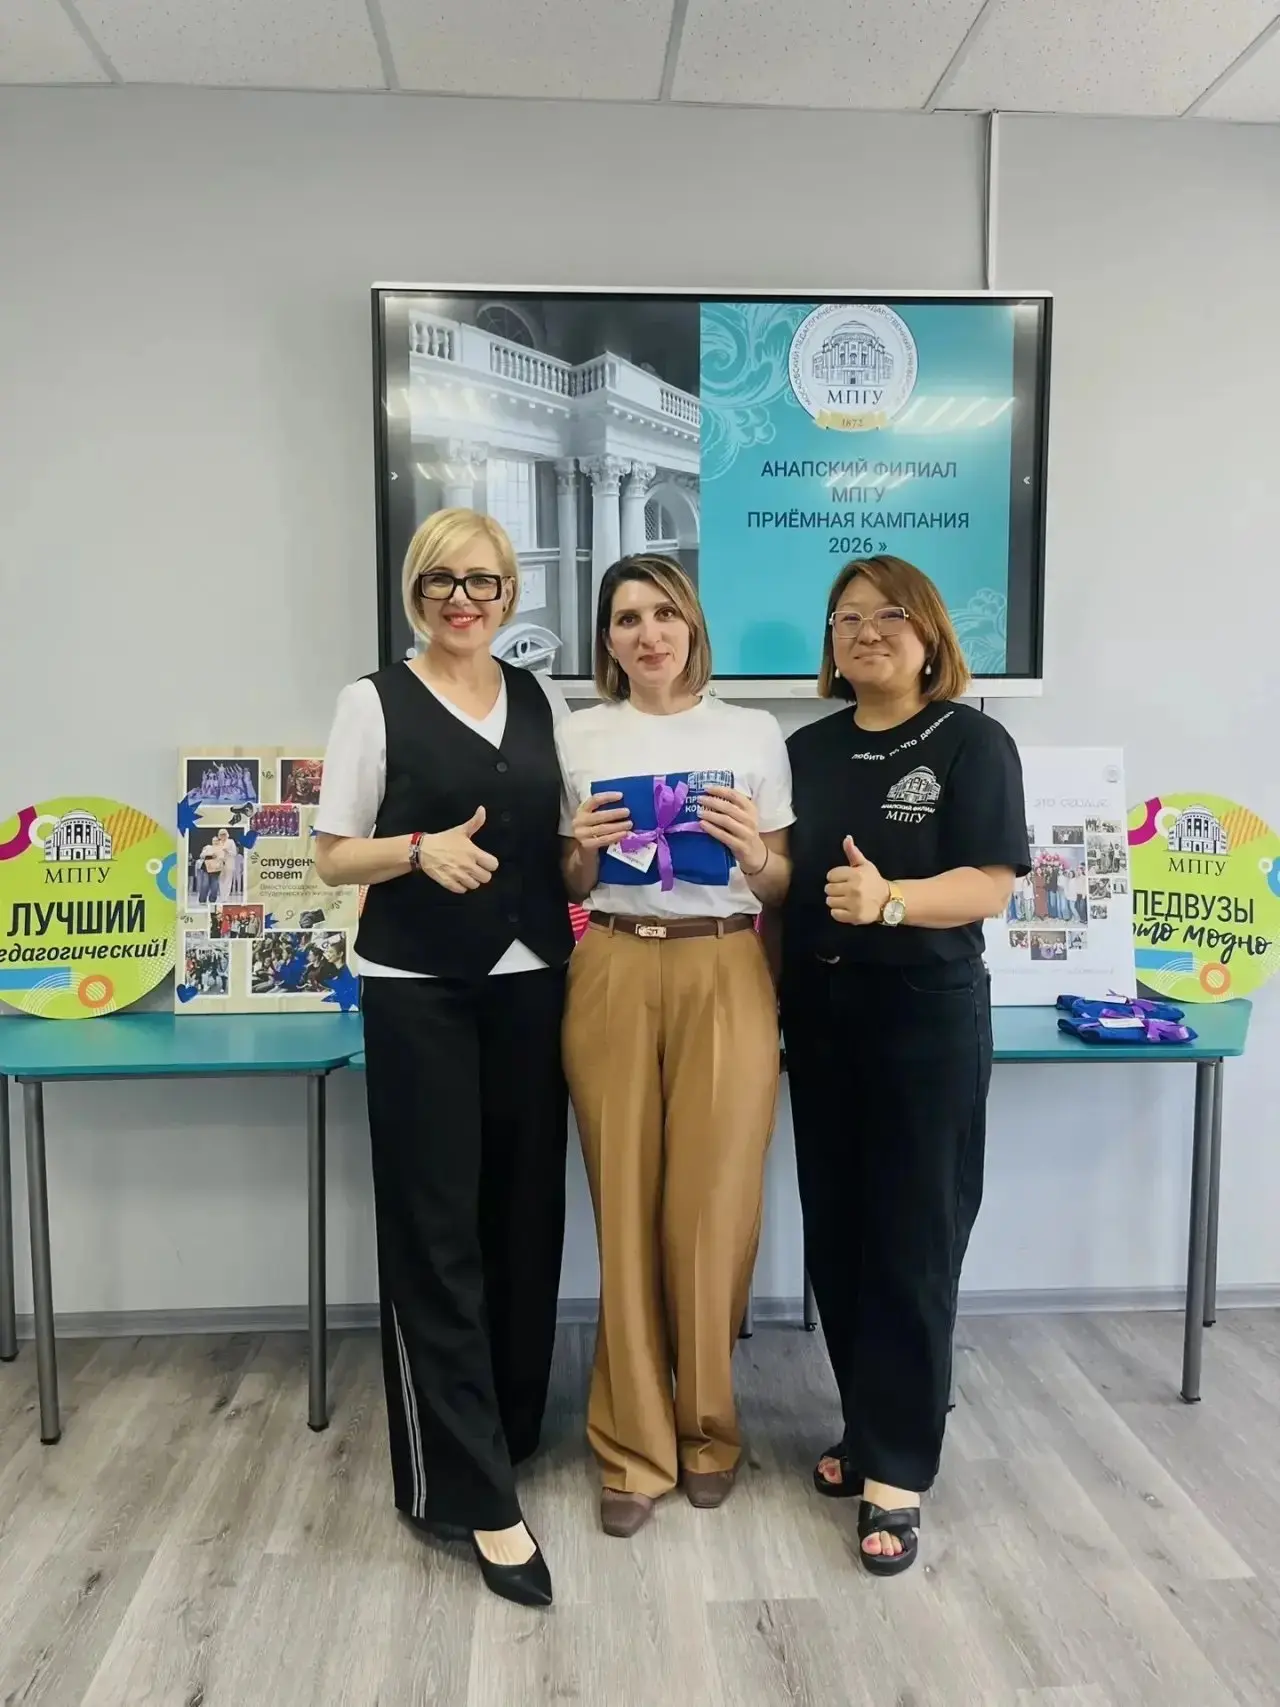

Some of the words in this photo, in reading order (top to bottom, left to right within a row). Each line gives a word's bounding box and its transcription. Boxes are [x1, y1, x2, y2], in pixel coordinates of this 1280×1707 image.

[827, 390, 883, 405] МПГУ
[761, 458, 868, 477] АНАПСКИЙ
[873, 461, 957, 478] ФИЛИАЛ
[832, 486, 886, 503] МПГУ
[747, 509, 855, 528] ПРИЁМНАЯ
[861, 511, 969, 528] КАМПАНИЯ
[829, 537, 873, 553] 2026
[851, 752, 885, 760] любить
[900, 739, 917, 749] что
[885, 810, 926, 823] МПГУ
[44, 867, 112, 884] МПГУ
[260, 871, 302, 880] совет
[1168, 857, 1226, 876] МПГУ
[7, 894, 145, 937] ЛУЧШИЙ
[1133, 889, 1253, 924] ПЕДВУЗЫ
[0, 939, 168, 962] едагогический!
[1182, 925, 1273, 965] модно
